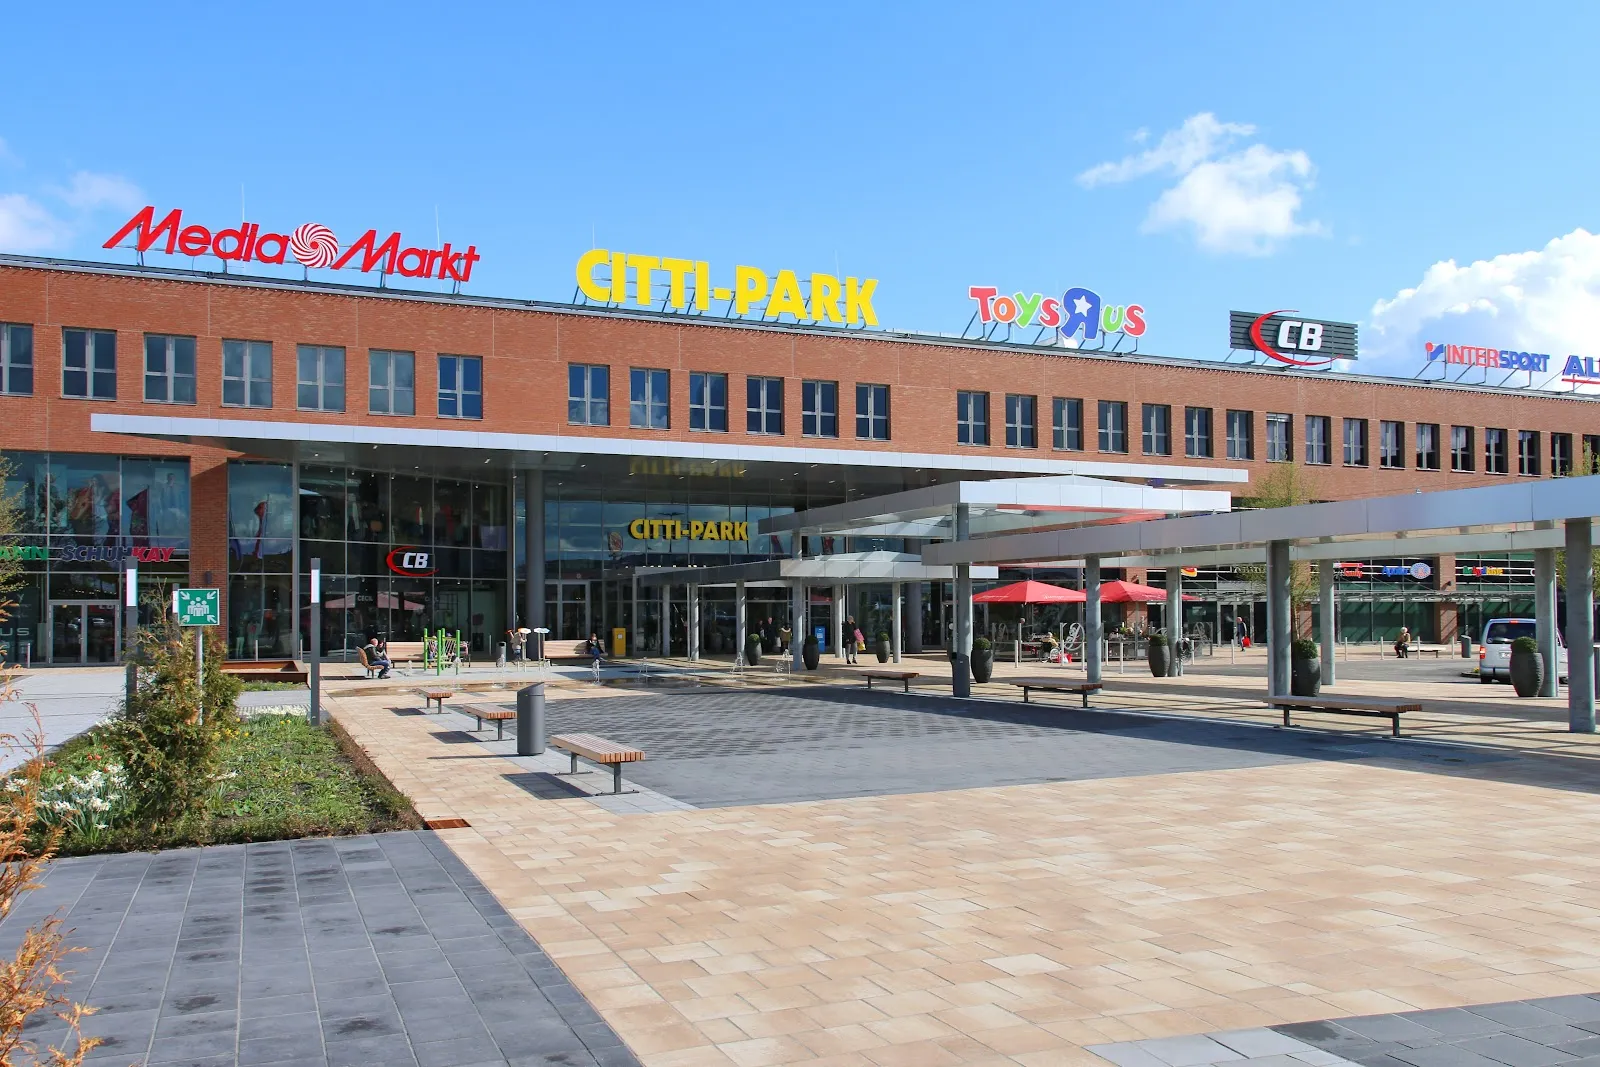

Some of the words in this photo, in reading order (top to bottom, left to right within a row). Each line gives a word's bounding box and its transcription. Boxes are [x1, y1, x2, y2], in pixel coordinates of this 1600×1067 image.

[103, 205, 290, 265] Media
[333, 229, 480, 282] Markt
[576, 248, 879, 326] CITTI-PARK
[1278, 320, 1324, 351] CB
[1446, 343, 1550, 372] INTERSPORT
[1562, 354, 1600, 378] AL
[629, 519, 749, 541] CITTI-PARK
[402, 552, 428, 569] CB
